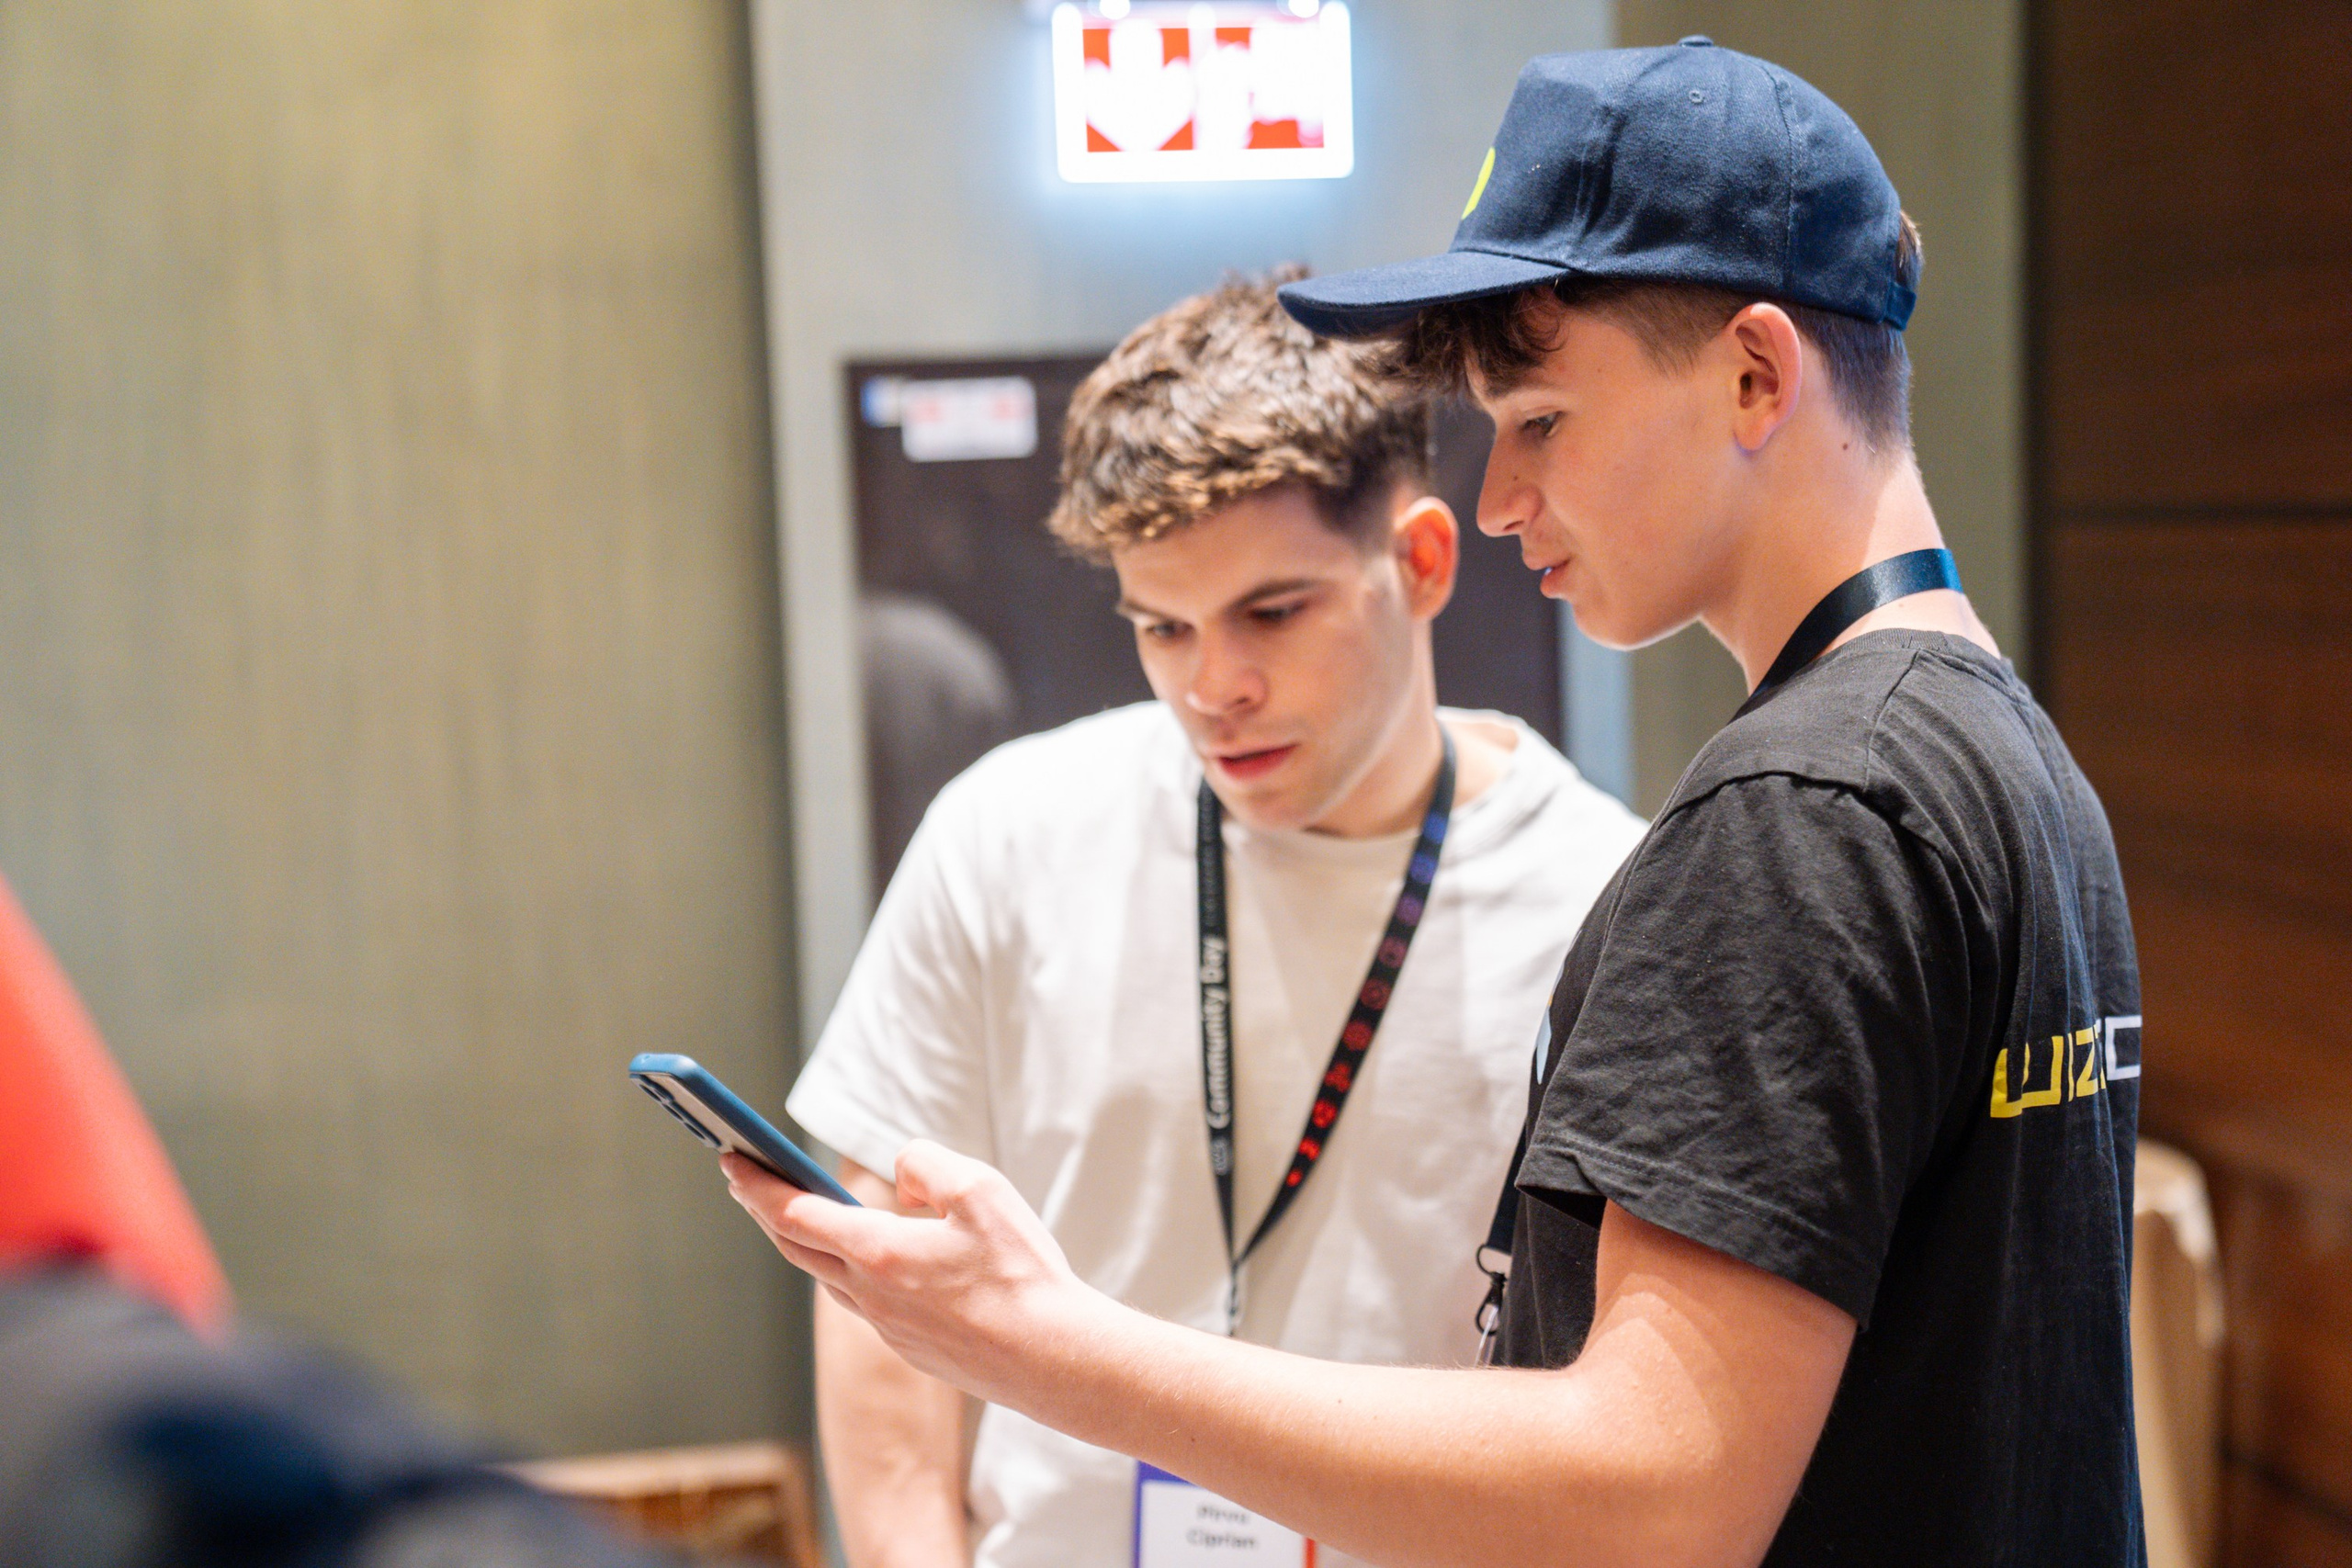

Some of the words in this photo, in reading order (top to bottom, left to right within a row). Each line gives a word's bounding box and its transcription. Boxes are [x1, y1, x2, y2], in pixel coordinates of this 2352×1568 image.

[1201, 936, 1227, 984] Day
[1204, 986, 1230, 1128] Community
[1186, 1528, 1257, 1548] Ciprian
